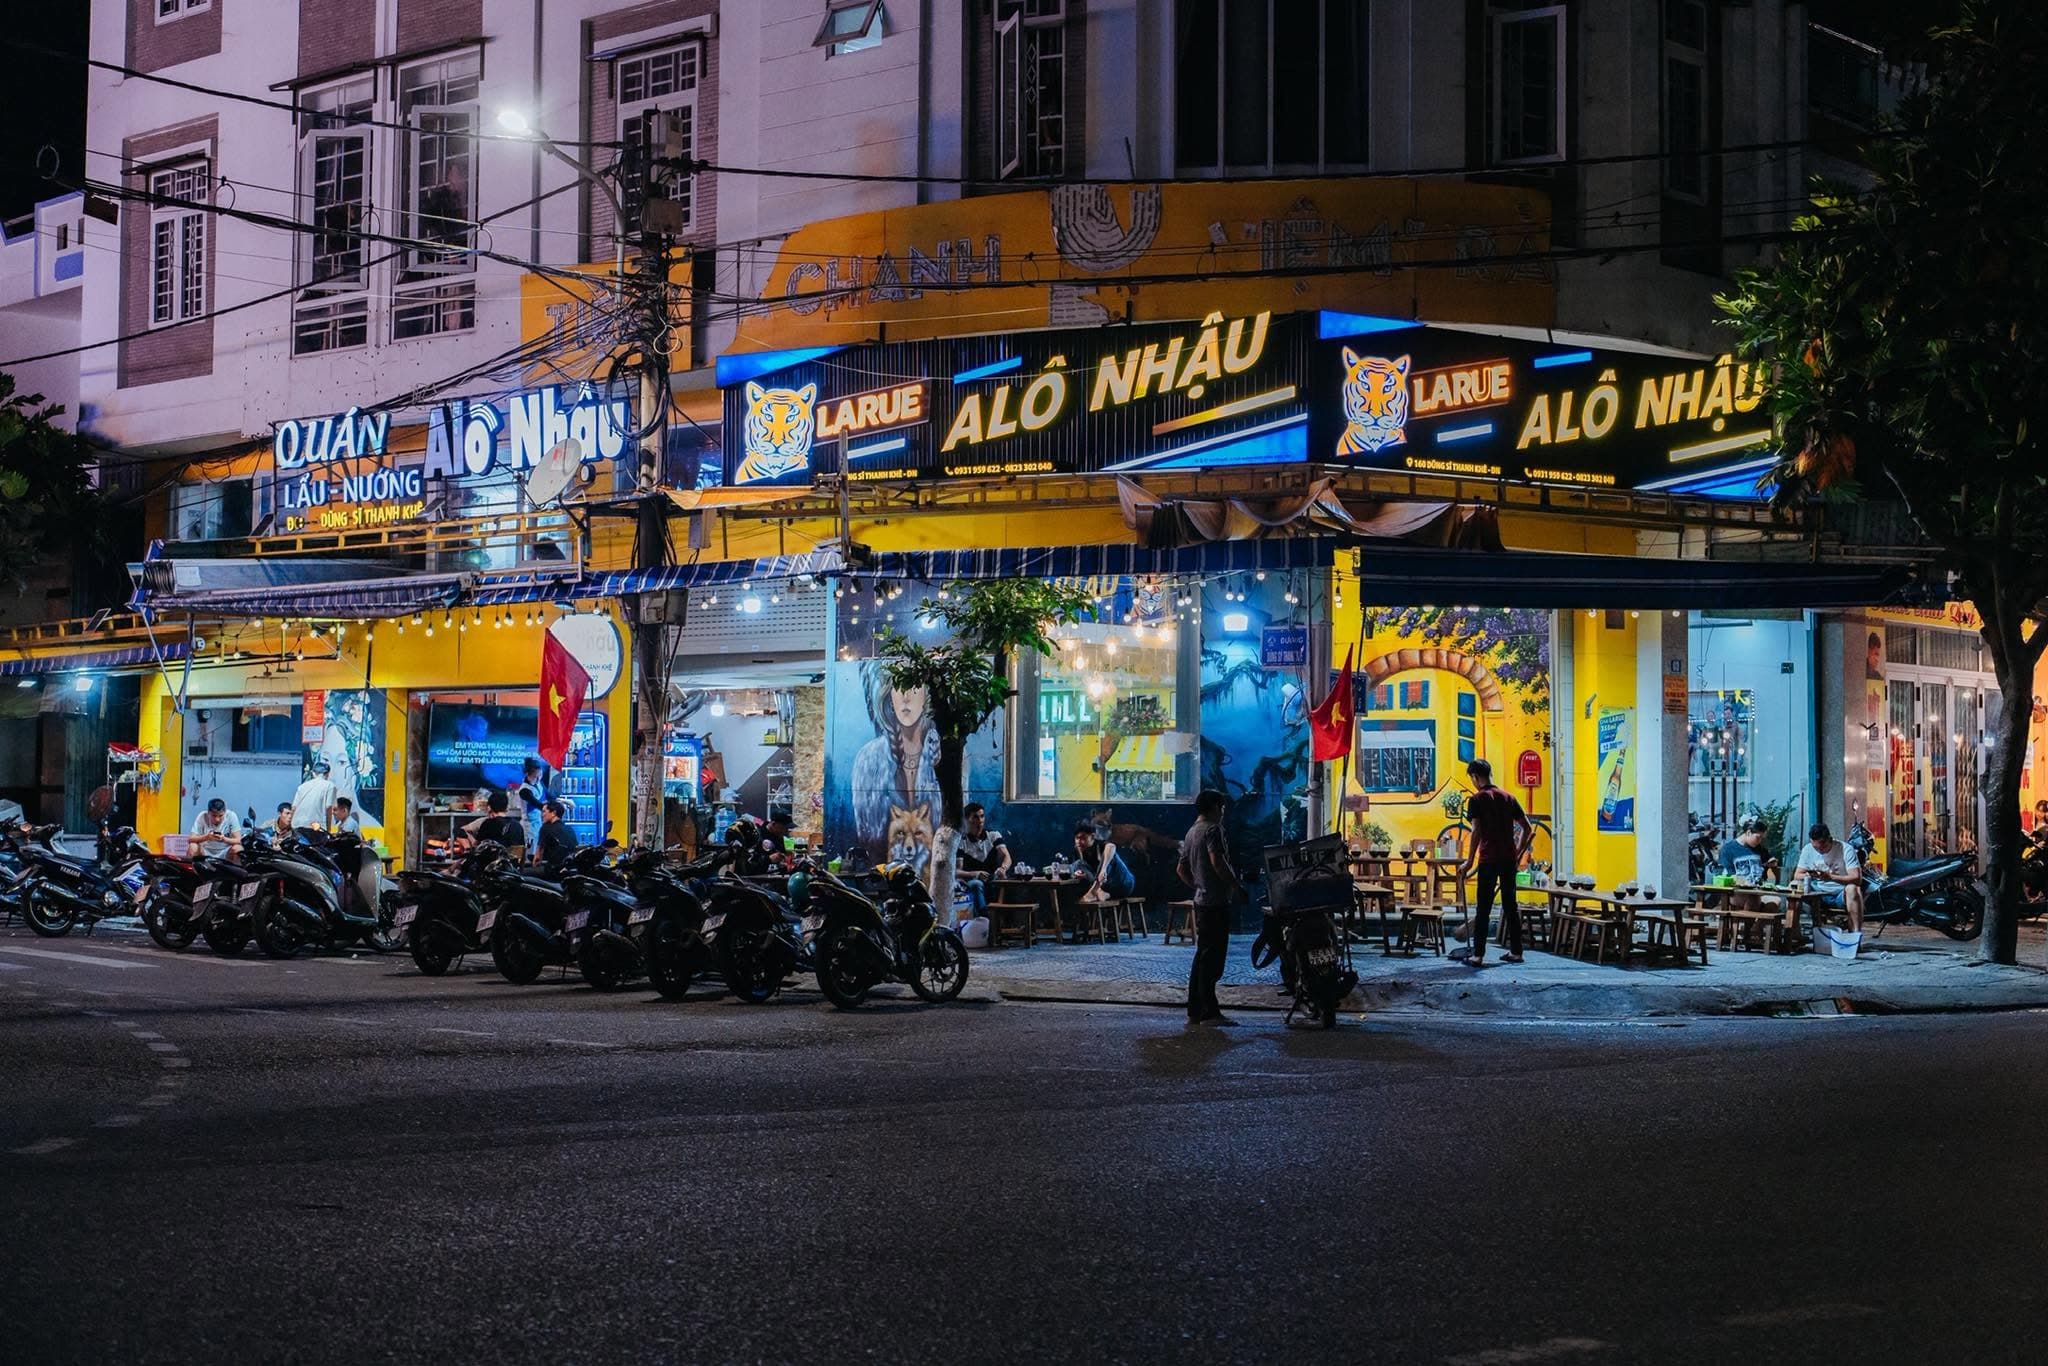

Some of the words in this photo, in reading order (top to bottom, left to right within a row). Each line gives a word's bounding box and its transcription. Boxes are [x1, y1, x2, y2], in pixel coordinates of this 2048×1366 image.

[785, 235, 1001, 316] CHANH
[941, 355, 1067, 452] ALÔ
[1089, 310, 1271, 412] NHẬU
[1412, 364, 1510, 413] LARUE
[1516, 368, 1619, 450] ALÔ
[1634, 353, 1764, 432] NHẬU
[816, 384, 923, 438] LARUE
[275, 406, 389, 469] QUÁN
[343, 467, 421, 503] NƯỚNG
[865, 470, 888, 480] THANH
[954, 466, 972, 475] 0931
[972, 466, 986, 474] 959
[987, 465, 1000, 473] 622
[1023, 463, 1037, 472] 302
[1452, 463, 1474, 473] THANH
[320, 511, 348, 528] DŨNG
[364, 505, 400, 524] THANH
